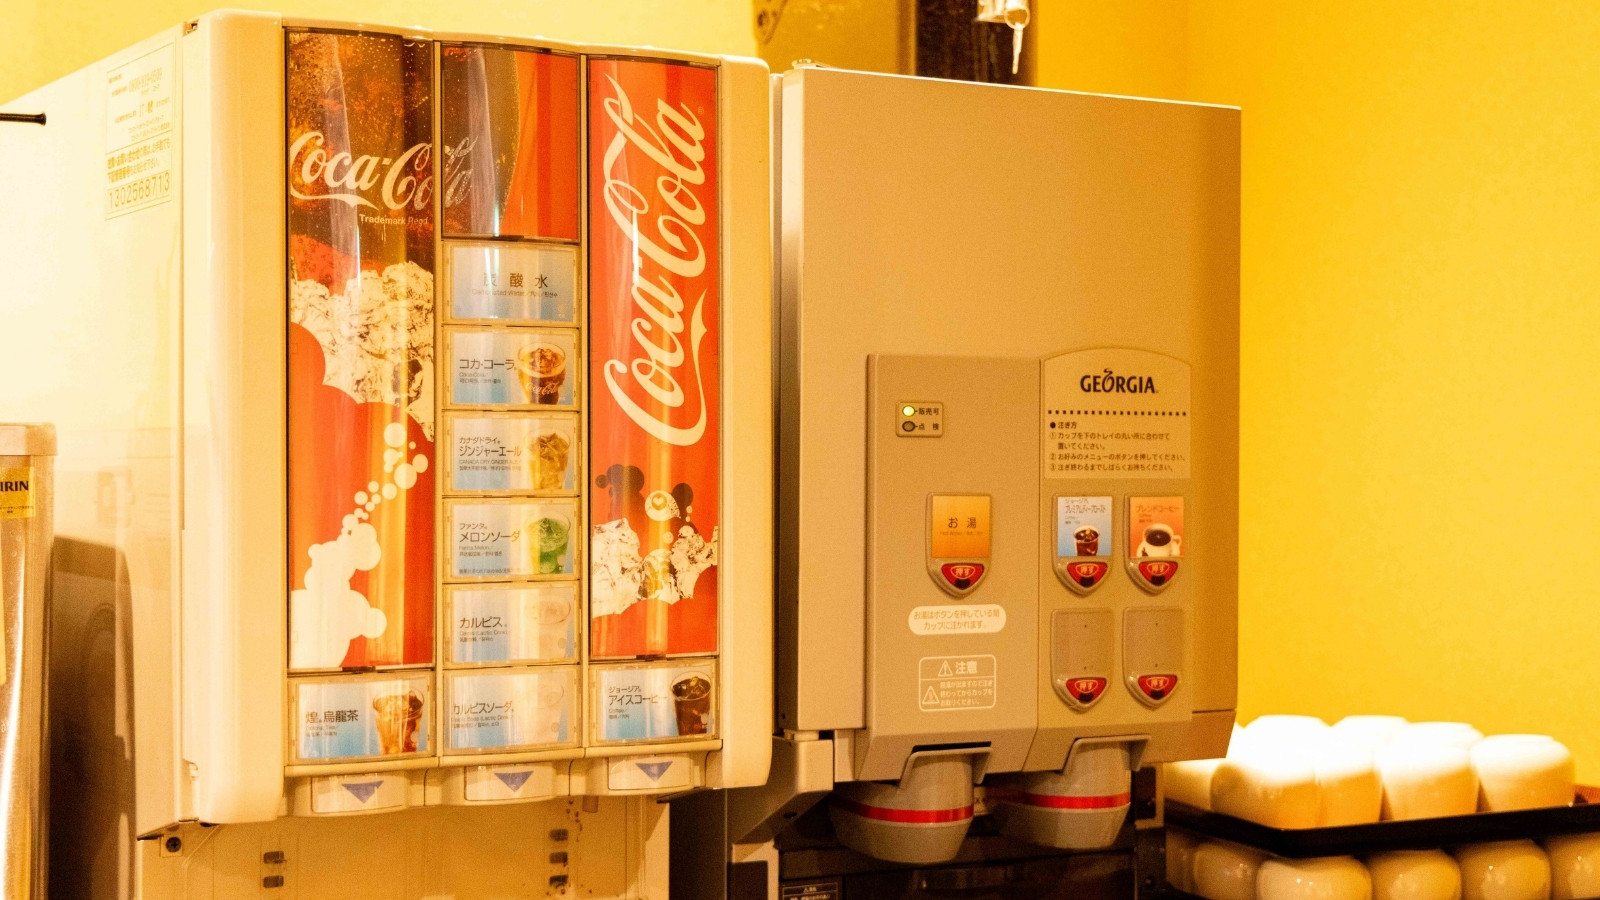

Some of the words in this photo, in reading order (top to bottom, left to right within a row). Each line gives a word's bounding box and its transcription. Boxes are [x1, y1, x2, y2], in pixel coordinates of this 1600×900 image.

[108, 171, 170, 209] 1302568713
[359, 214, 405, 225] Trademark
[603, 72, 708, 447] Coca-Cola
[1080, 368, 1156, 393] GEORGIA
[459, 446, 522, 457] ジンジャーエール
[459, 531, 521, 543] メロンソーダ
[955, 567, 971, 577] 押す
[913, 609, 1000, 620] お湯はボタンを押している間
[460, 616, 503, 629] カルピス
[955, 660, 978, 674] 注意
[608, 694, 668, 706] アイスコーヒー
